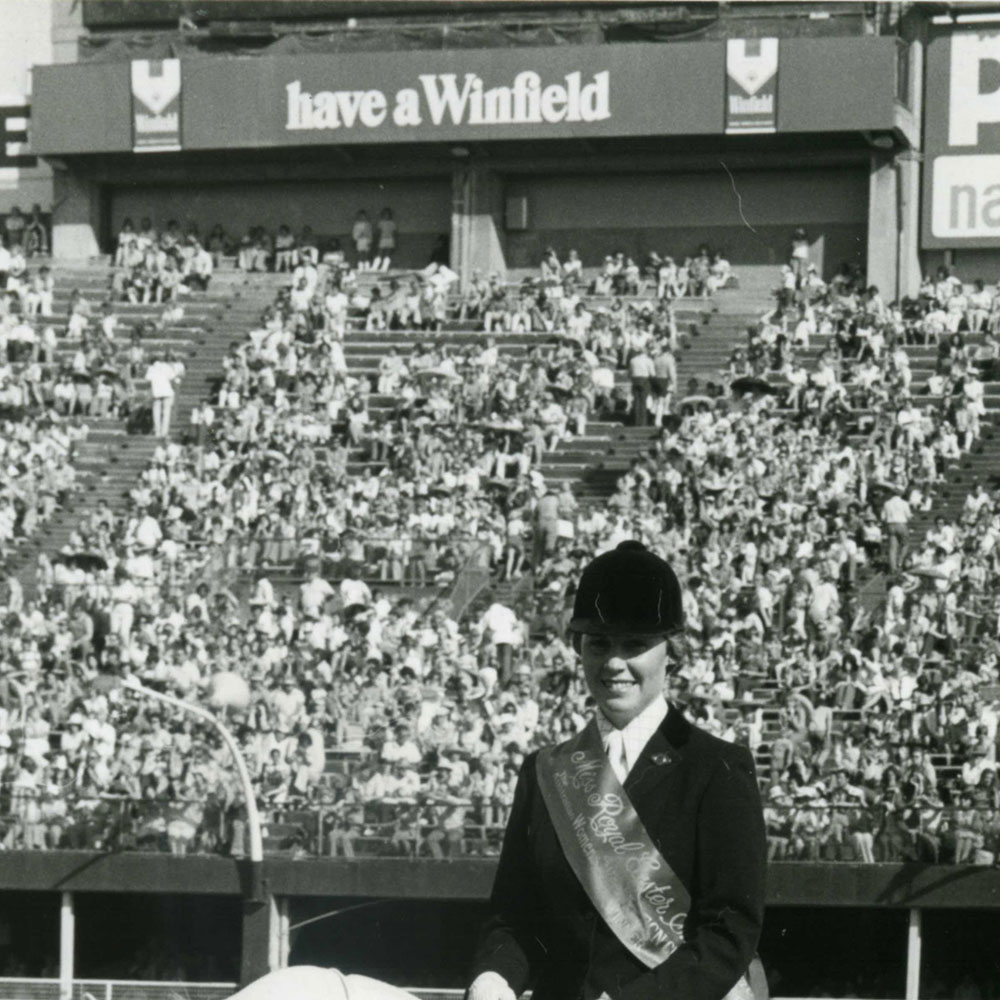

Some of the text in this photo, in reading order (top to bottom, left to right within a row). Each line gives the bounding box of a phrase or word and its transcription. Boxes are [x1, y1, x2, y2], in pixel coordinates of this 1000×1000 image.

[285, 71, 611, 130] have a Winfield
[571, 751, 604, 793] Miss
[587, 793, 645, 855] Royal
